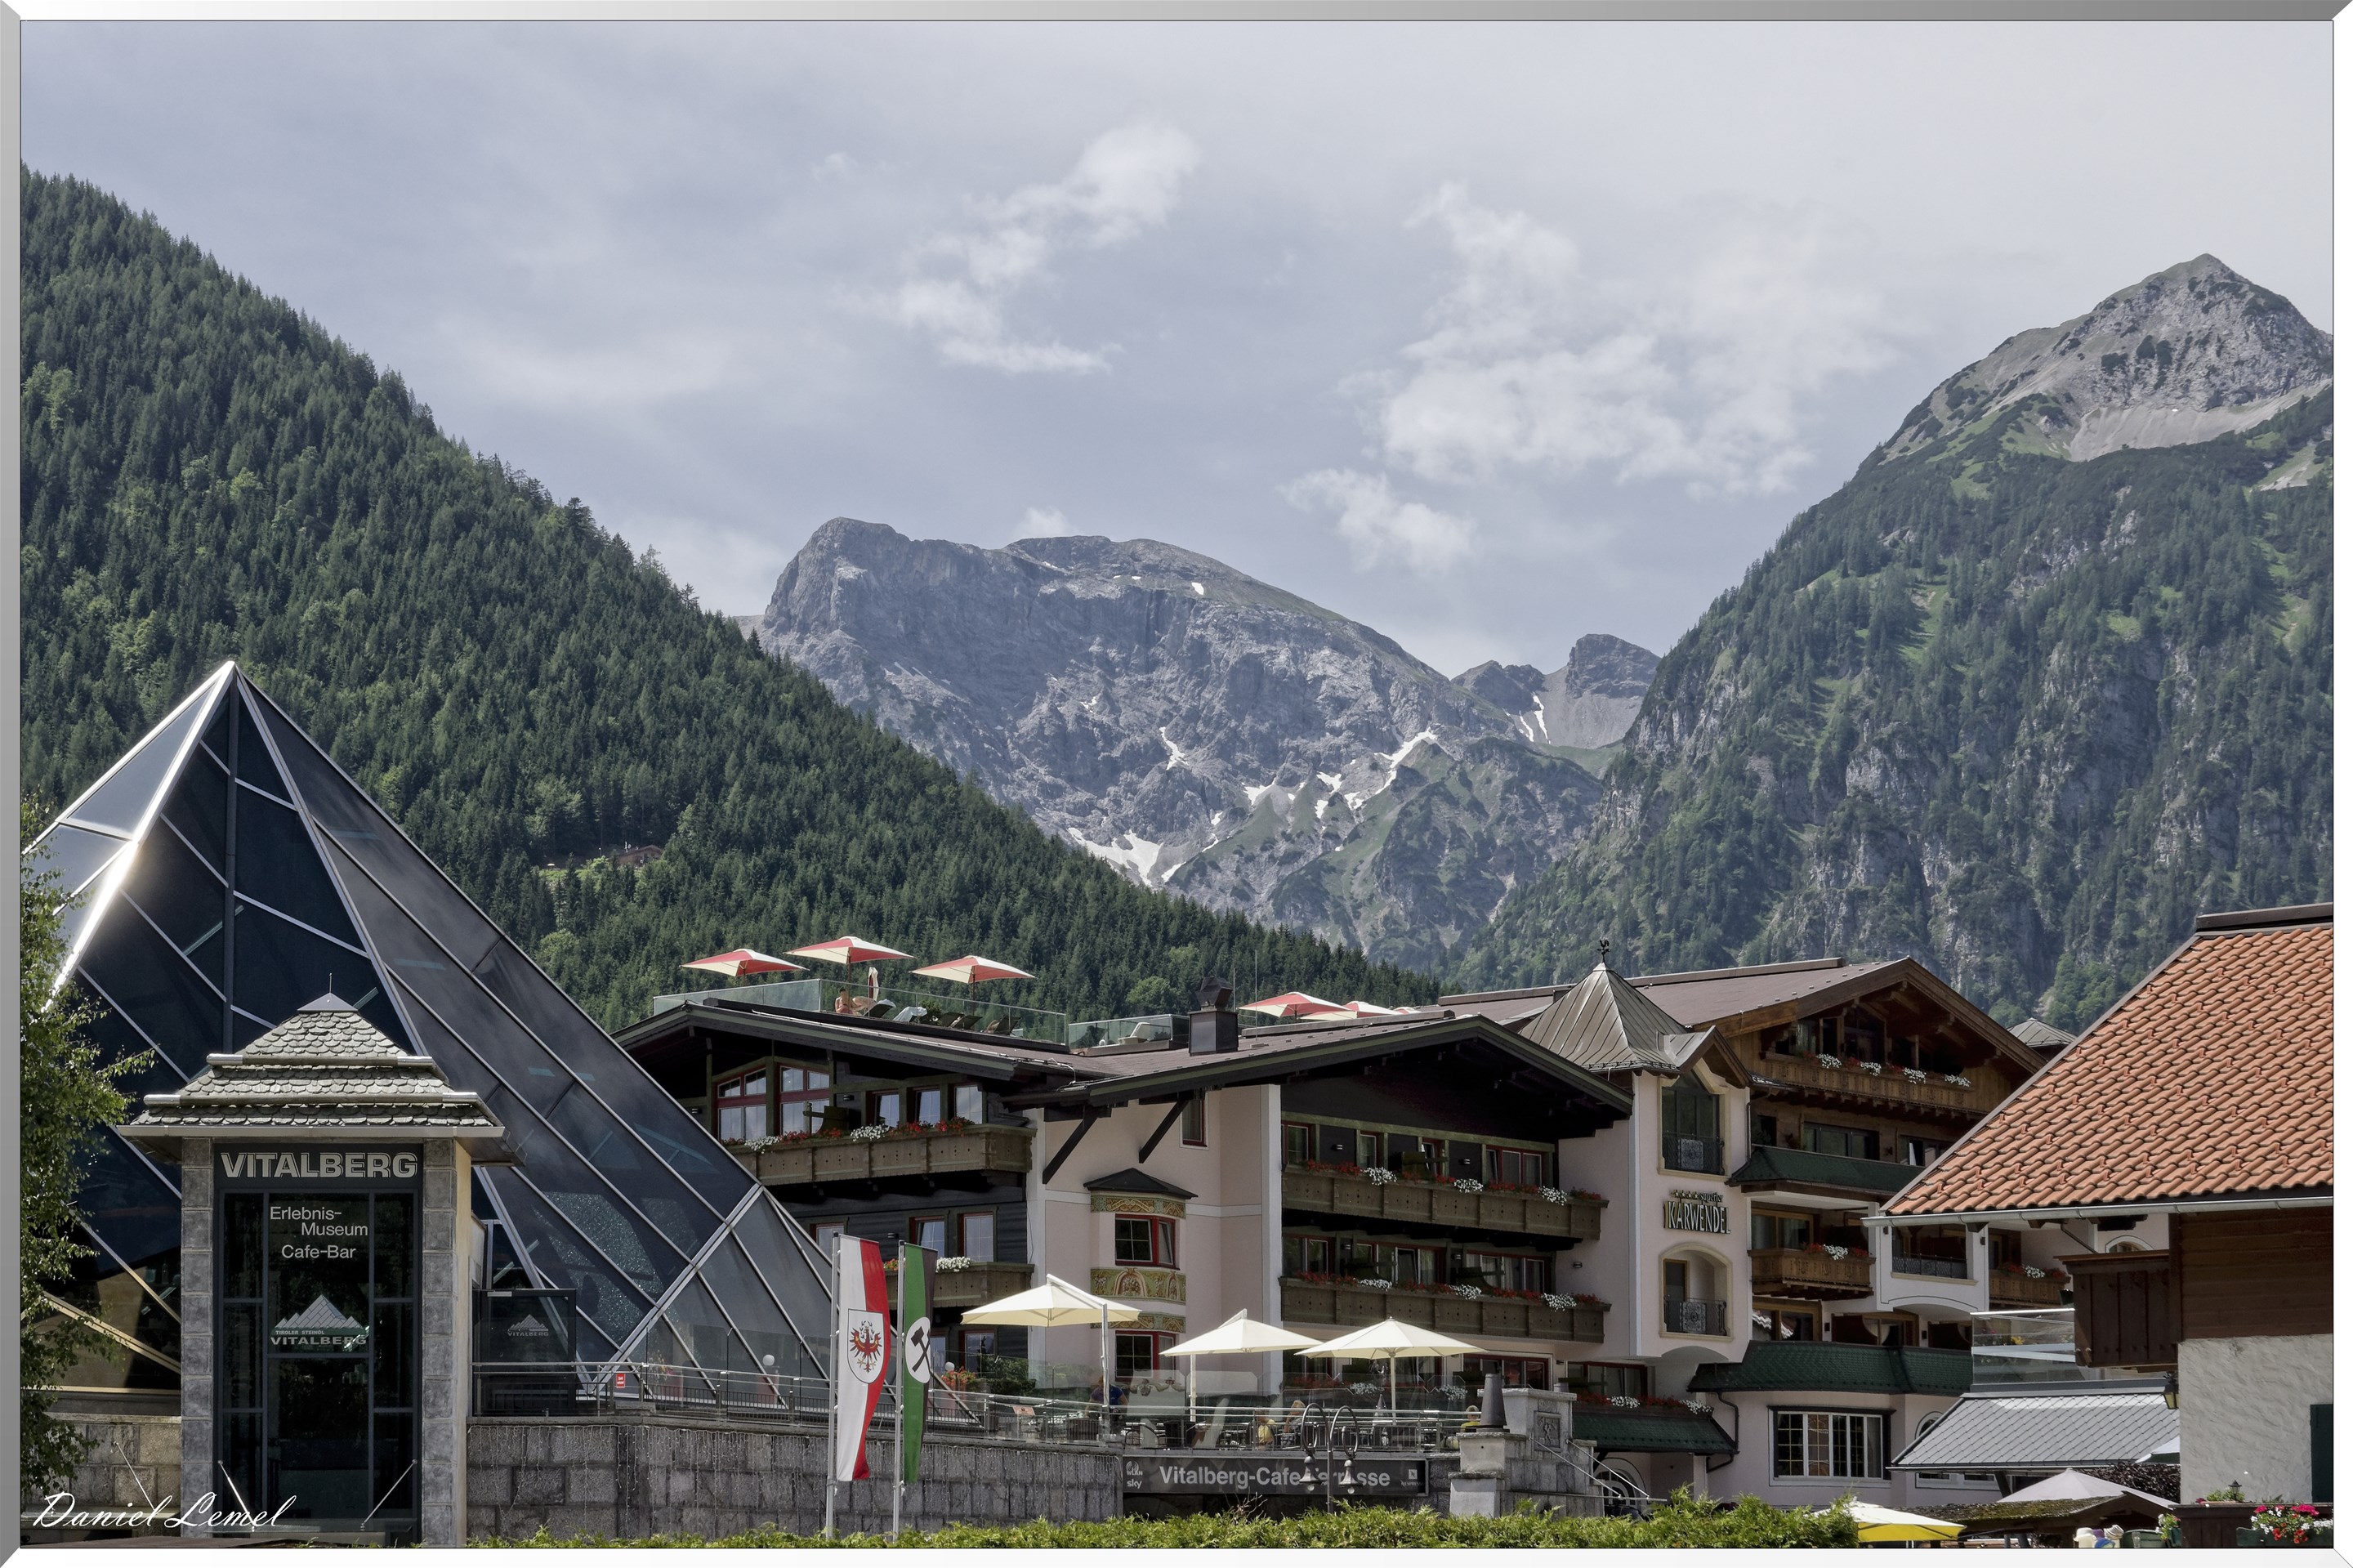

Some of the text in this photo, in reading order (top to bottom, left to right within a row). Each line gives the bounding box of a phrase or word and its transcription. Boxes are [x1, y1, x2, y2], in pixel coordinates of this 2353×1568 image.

[221, 1152, 417, 1178] VITALBERG
[270, 1206, 342, 1221] Erlebnis-
[1667, 1201, 1731, 1234] KARWENDEL
[301, 1222, 368, 1236] Museum
[281, 1244, 356, 1259] Cafe-Bar
[270, 1336, 367, 1345] VITALBERG
[1127, 1478, 1143, 1489] sky
[1159, 1466, 1391, 1490] Vitalberg-Cafe ersse
